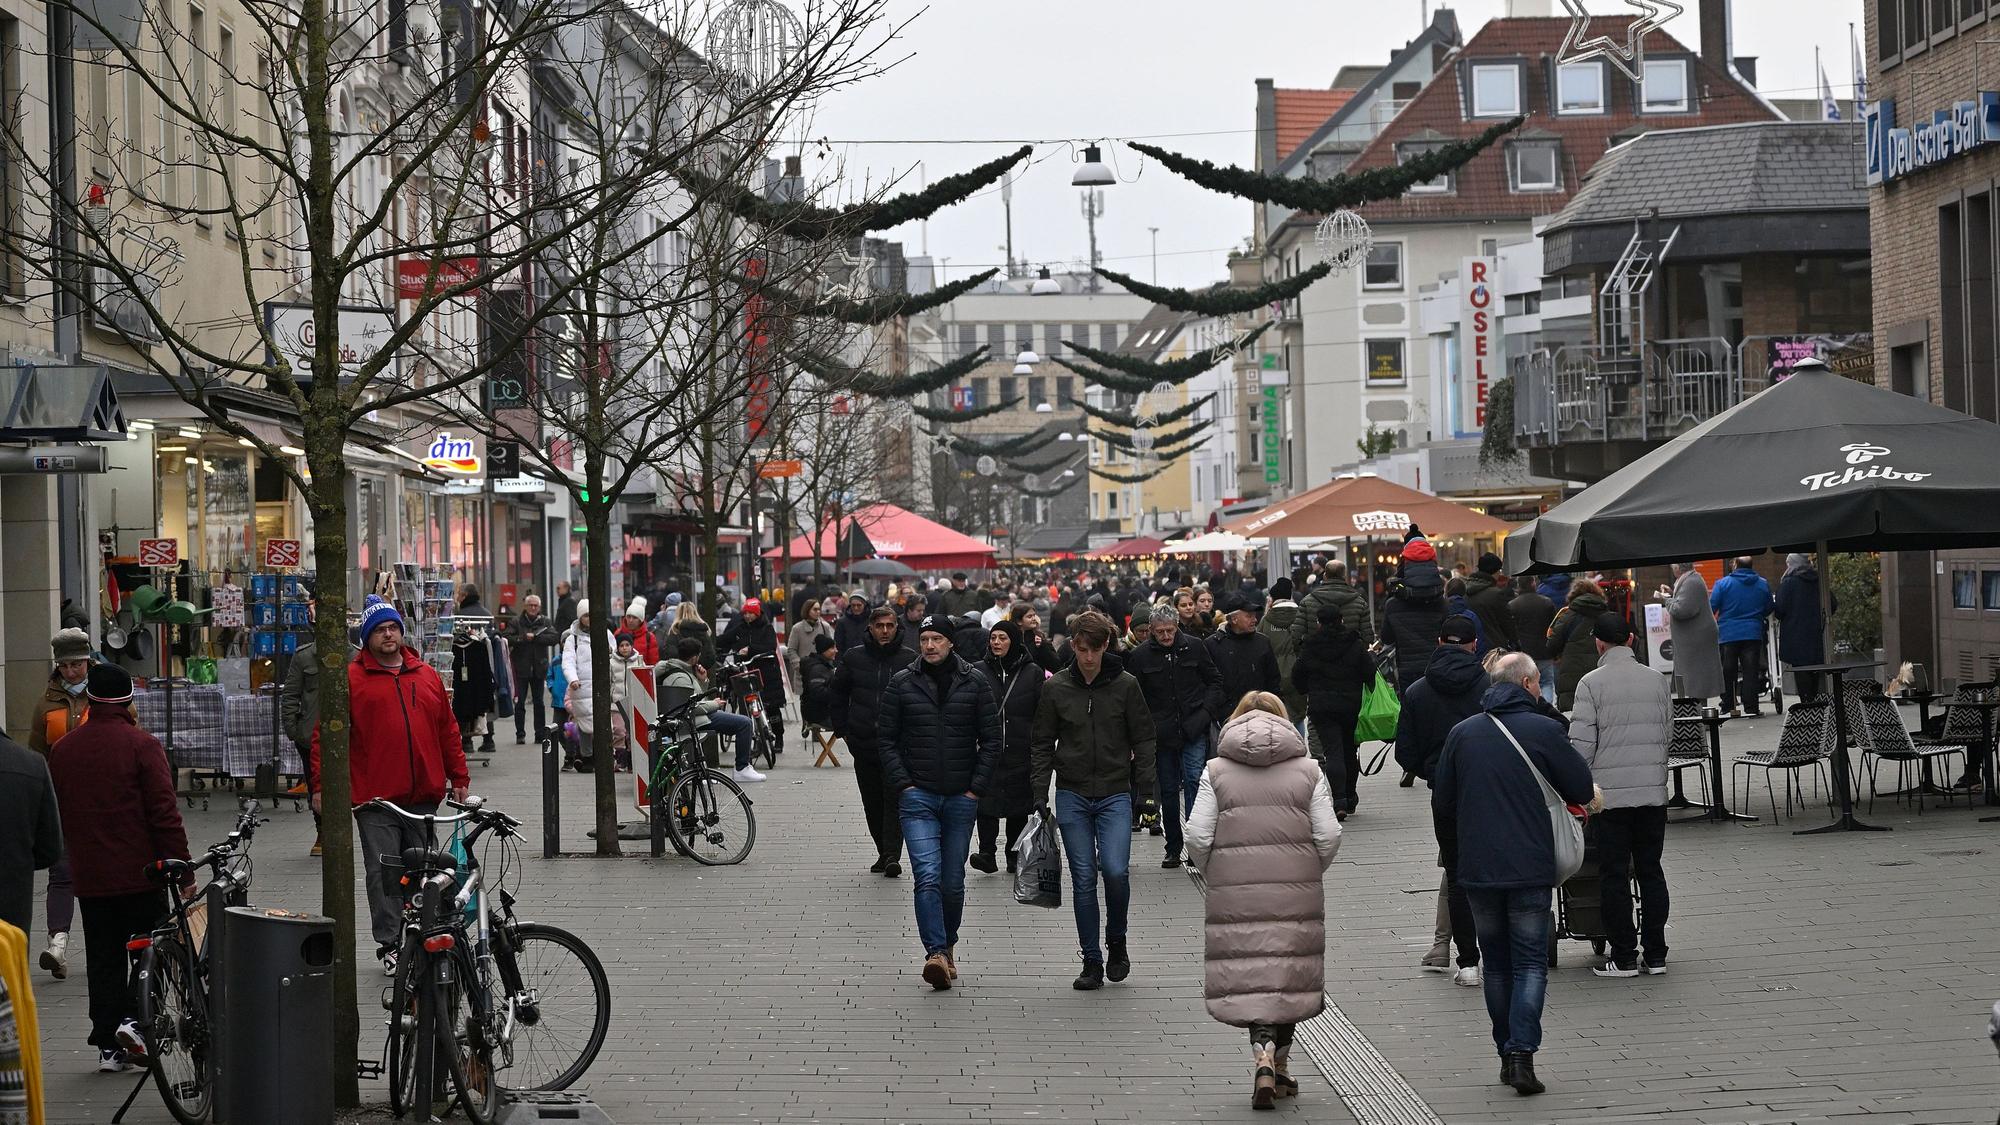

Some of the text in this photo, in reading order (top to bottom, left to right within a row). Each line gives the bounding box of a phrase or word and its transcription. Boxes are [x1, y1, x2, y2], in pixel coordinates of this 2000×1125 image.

[1888, 91, 1990, 178] Deutsche Bank
[1263, 354, 1280, 482] DEICHMAN
[431, 435, 471, 459] dm
[1800, 465, 1932, 491] Tchibo
[1355, 521, 1412, 532] WERK
[1356, 514, 1406, 524] back
